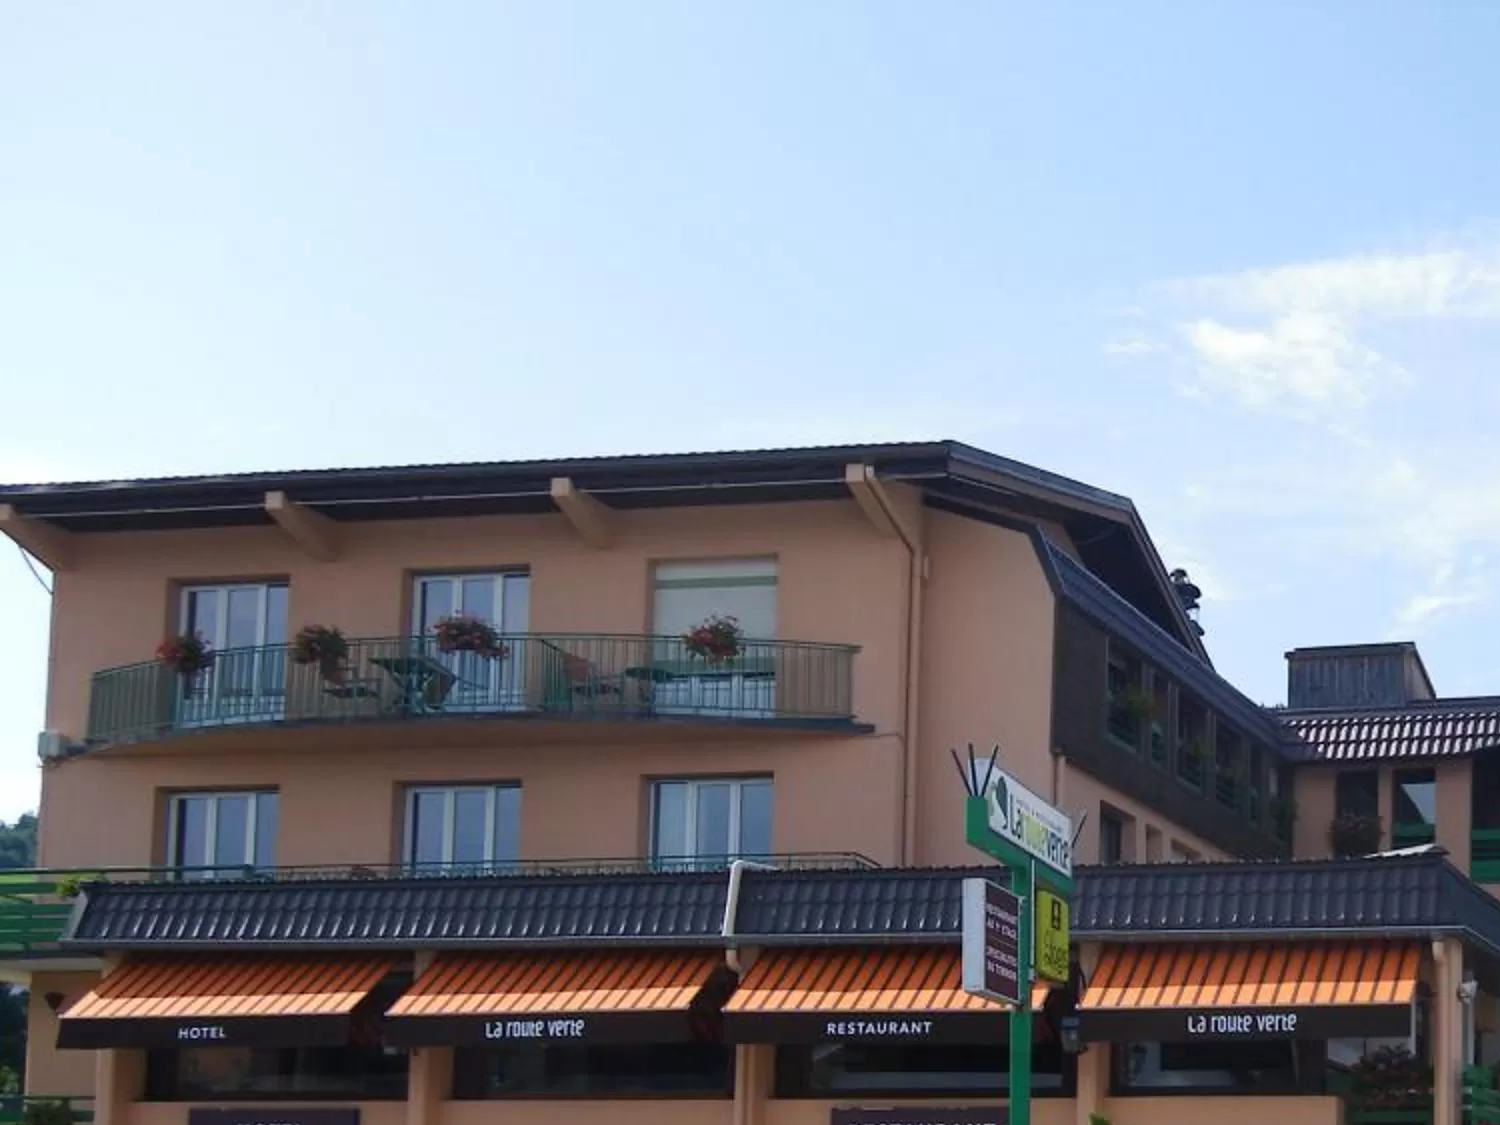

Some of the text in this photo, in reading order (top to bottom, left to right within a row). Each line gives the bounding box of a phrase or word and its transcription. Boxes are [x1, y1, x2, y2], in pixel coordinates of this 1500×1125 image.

[485, 1019, 585, 1039] La route verte
[827, 1021, 932, 1036] RESTAURANT
[1187, 1013, 1297, 1033] La route verte
[177, 1027, 226, 1040] HOTEL
